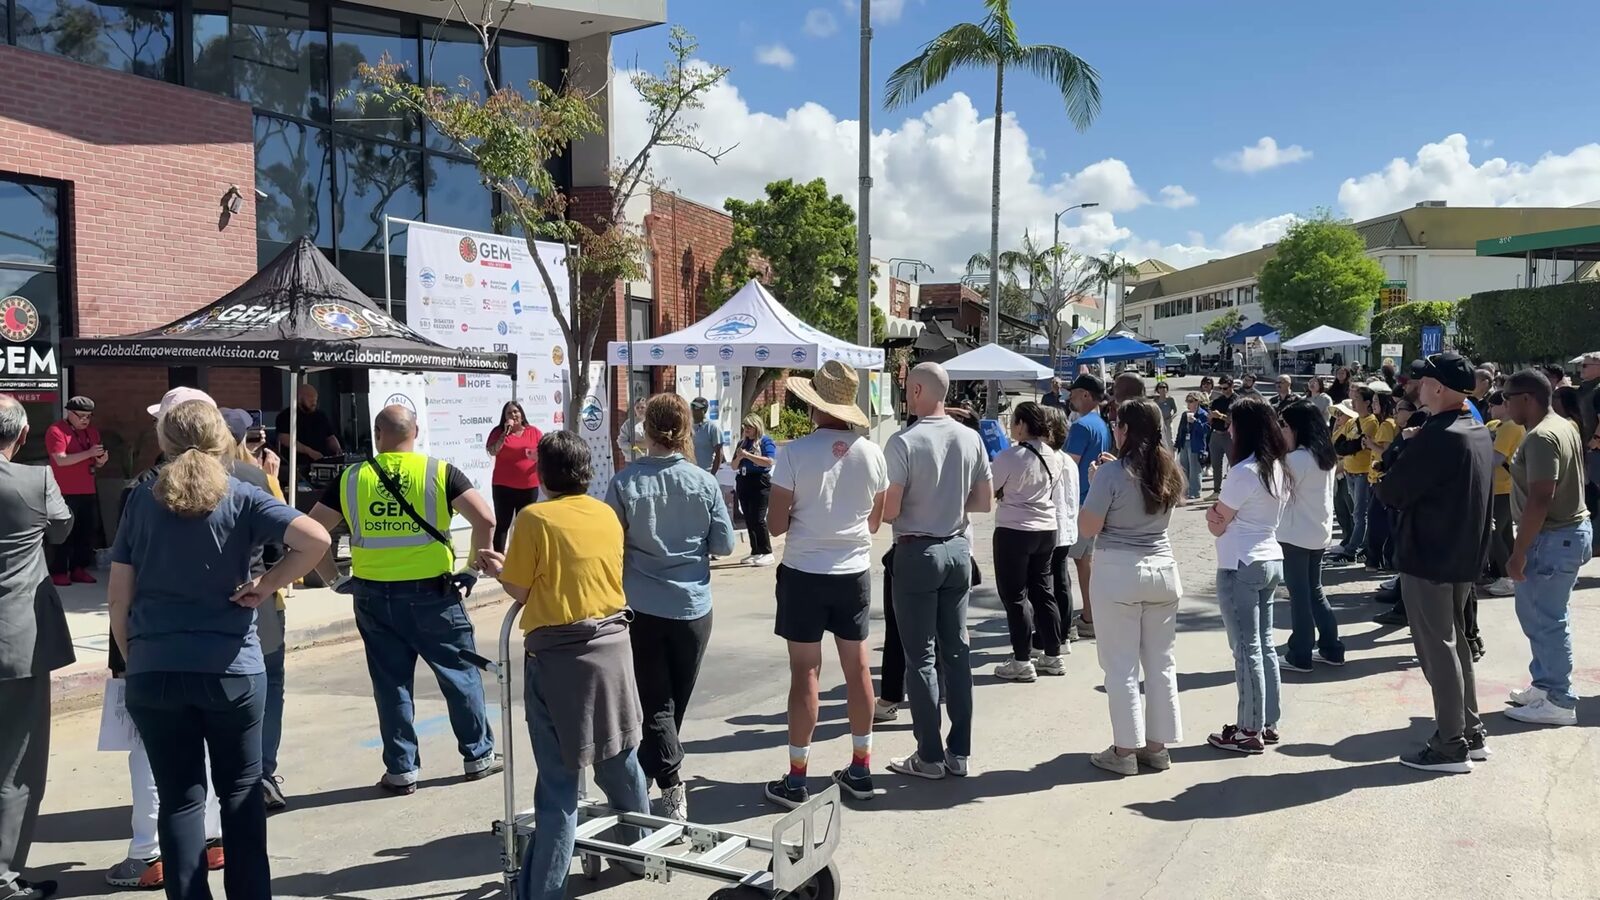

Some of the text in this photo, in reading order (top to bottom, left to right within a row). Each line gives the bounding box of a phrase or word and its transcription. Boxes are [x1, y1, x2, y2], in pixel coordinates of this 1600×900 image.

[480, 242, 511, 261] GEM
[445, 274, 463, 284] Rotary
[218, 304, 290, 324] GEM
[0, 346, 58, 375] EM
[467, 380, 491, 388] HOPE
[458, 415, 493, 425] ToolBANK
[364, 519, 421, 533] bstrong
